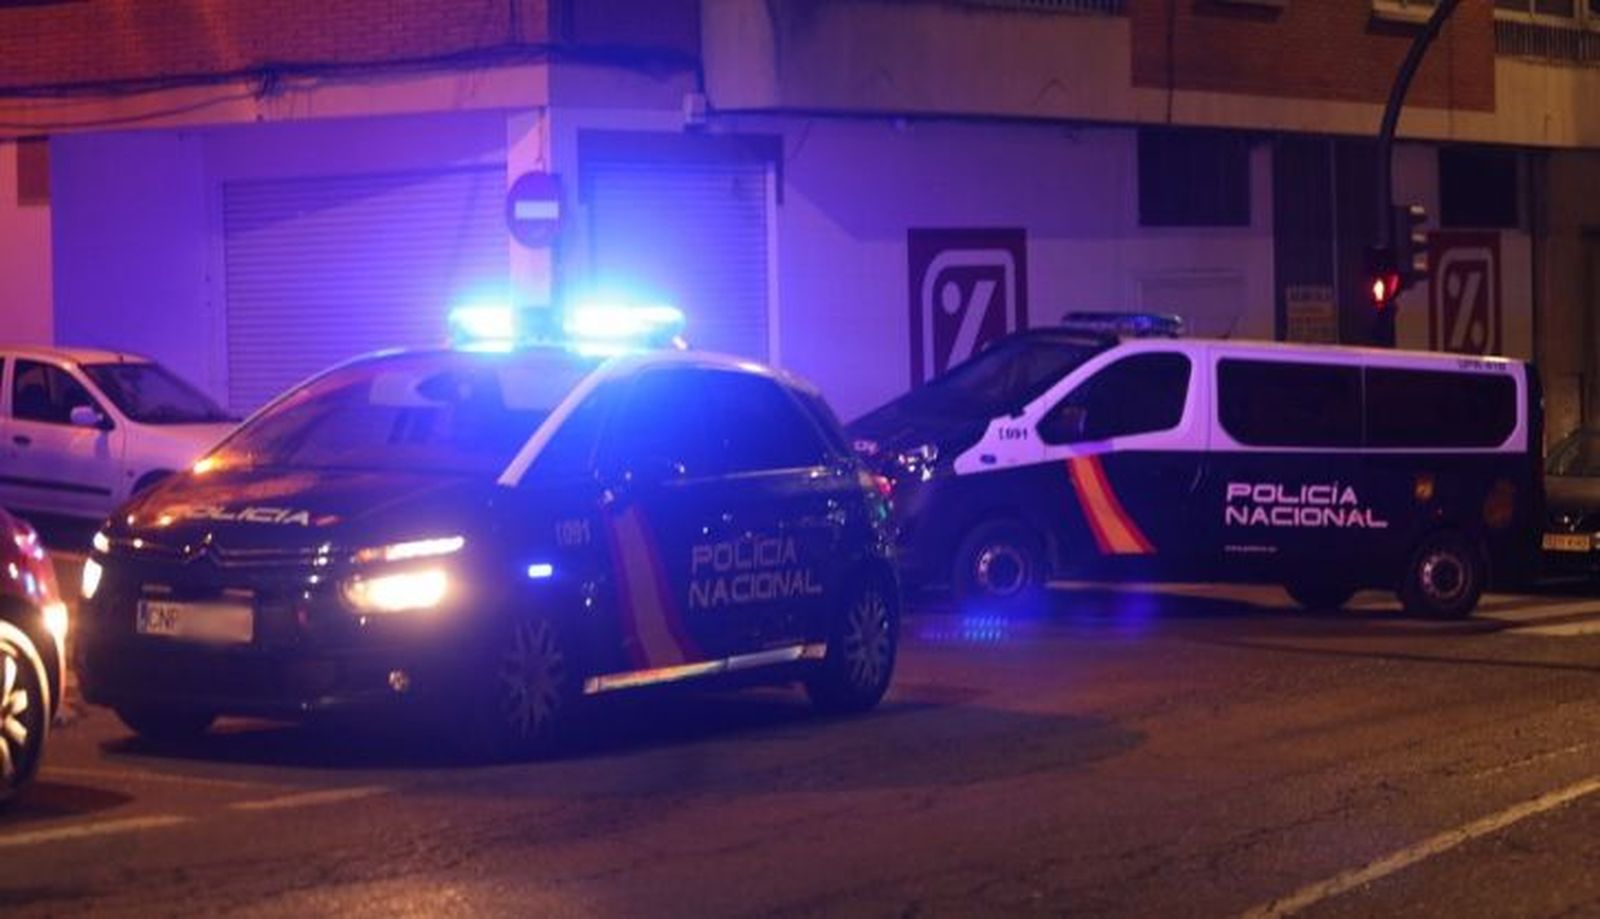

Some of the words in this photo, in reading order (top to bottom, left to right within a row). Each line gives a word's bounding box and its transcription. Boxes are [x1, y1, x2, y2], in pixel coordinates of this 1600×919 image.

[1225, 481, 1359, 506] POLICÍA
[1224, 506, 1389, 529] NACIONAL
[688, 567, 823, 609] NACIONAL
